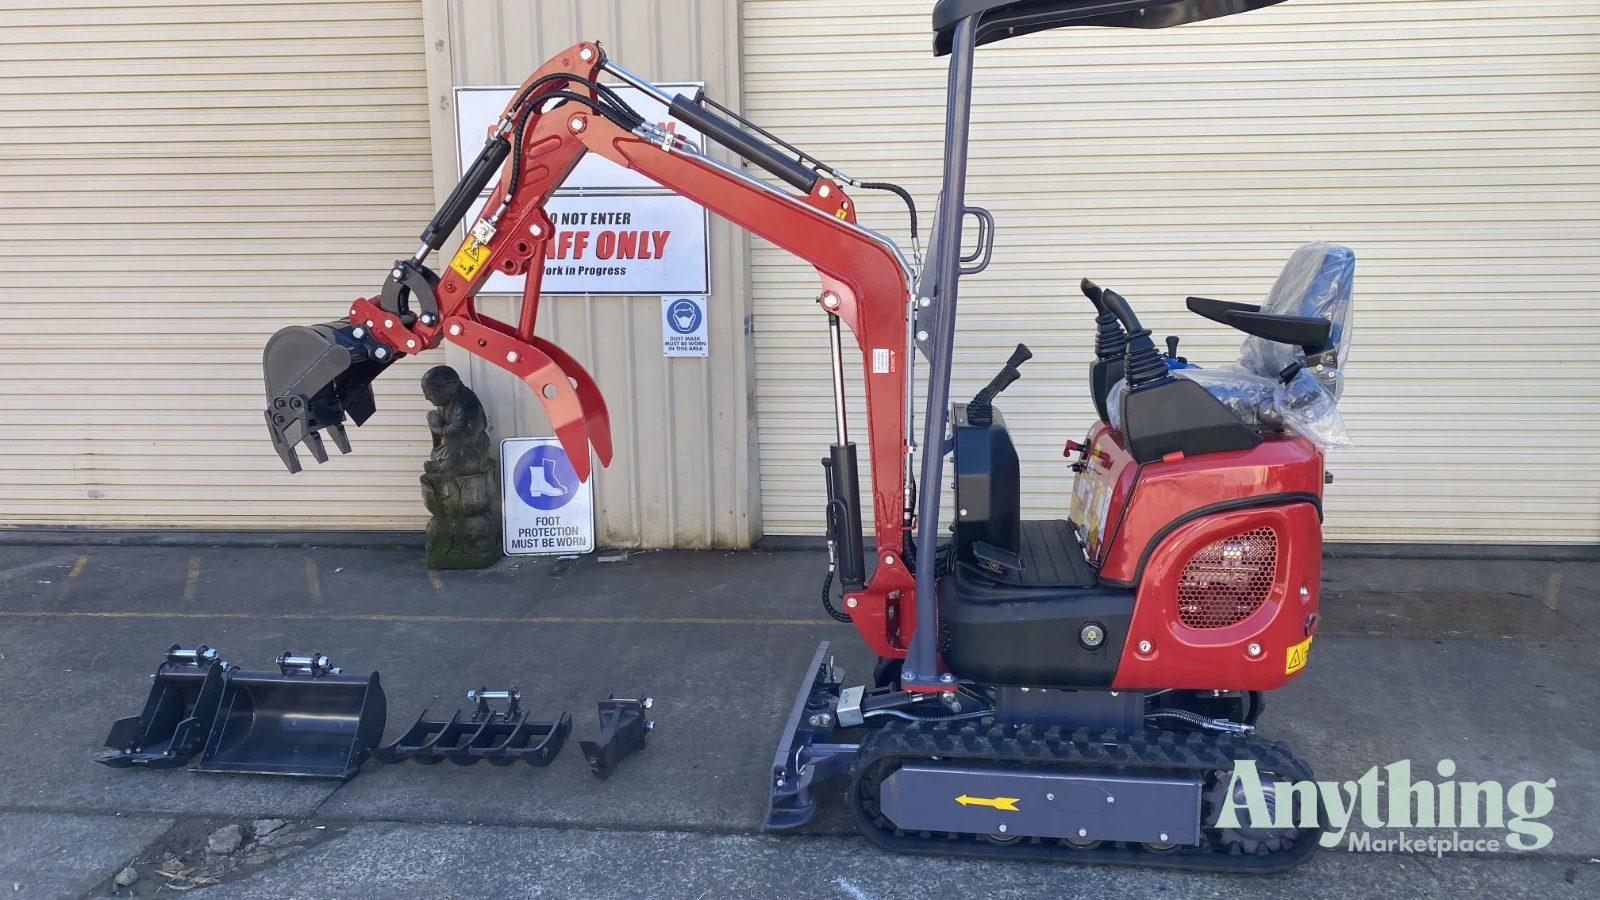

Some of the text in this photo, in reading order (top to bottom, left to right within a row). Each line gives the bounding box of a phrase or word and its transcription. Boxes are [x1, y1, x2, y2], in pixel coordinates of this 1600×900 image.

[546, 212, 631, 225] O NOT ENTER
[595, 230, 671, 260] ONLY
[542, 265, 626, 277] ork in Progress
[535, 516, 561, 527] FOOT
[518, 526, 579, 538] PROTECTION
[511, 536, 587, 549] MUST BE WORN
